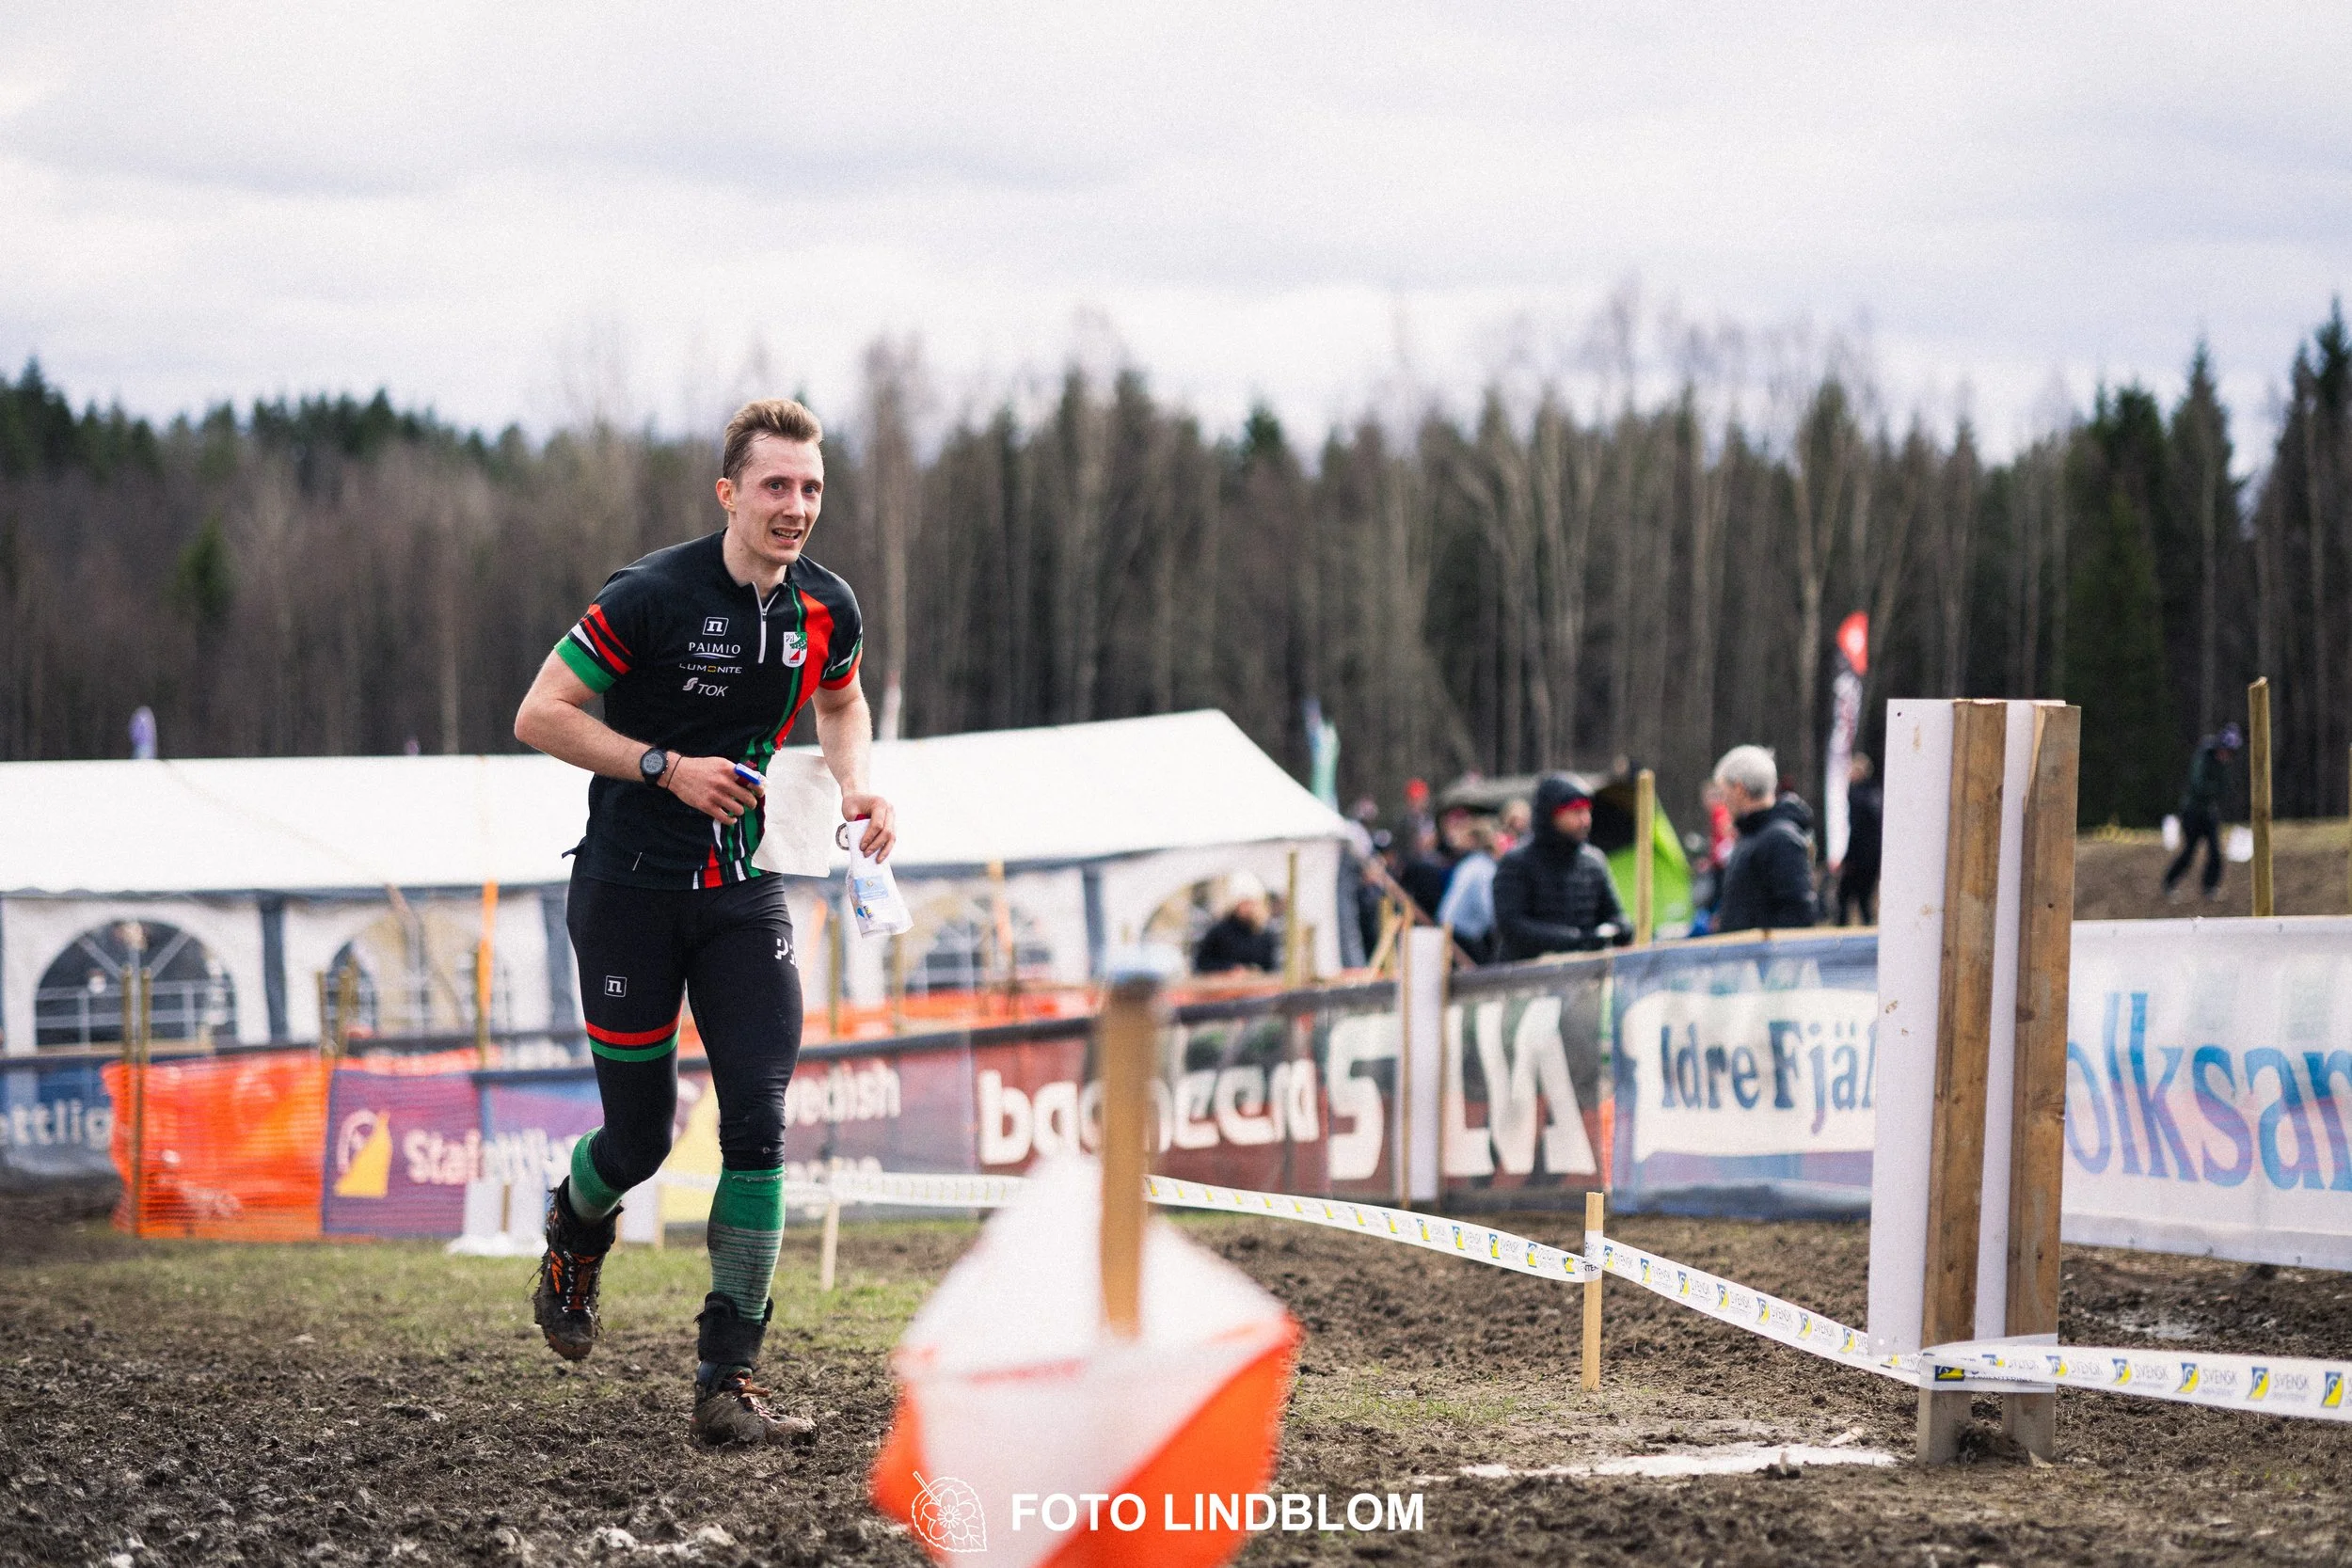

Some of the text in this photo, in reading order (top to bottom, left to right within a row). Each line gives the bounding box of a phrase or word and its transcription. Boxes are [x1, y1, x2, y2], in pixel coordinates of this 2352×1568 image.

[678, 663, 742, 673] LUMONITE
[689, 642, 741, 655] PAIMIO
[1327, 996, 1597, 1180] SLVA
[1661, 1022, 1760, 1110] Idre
